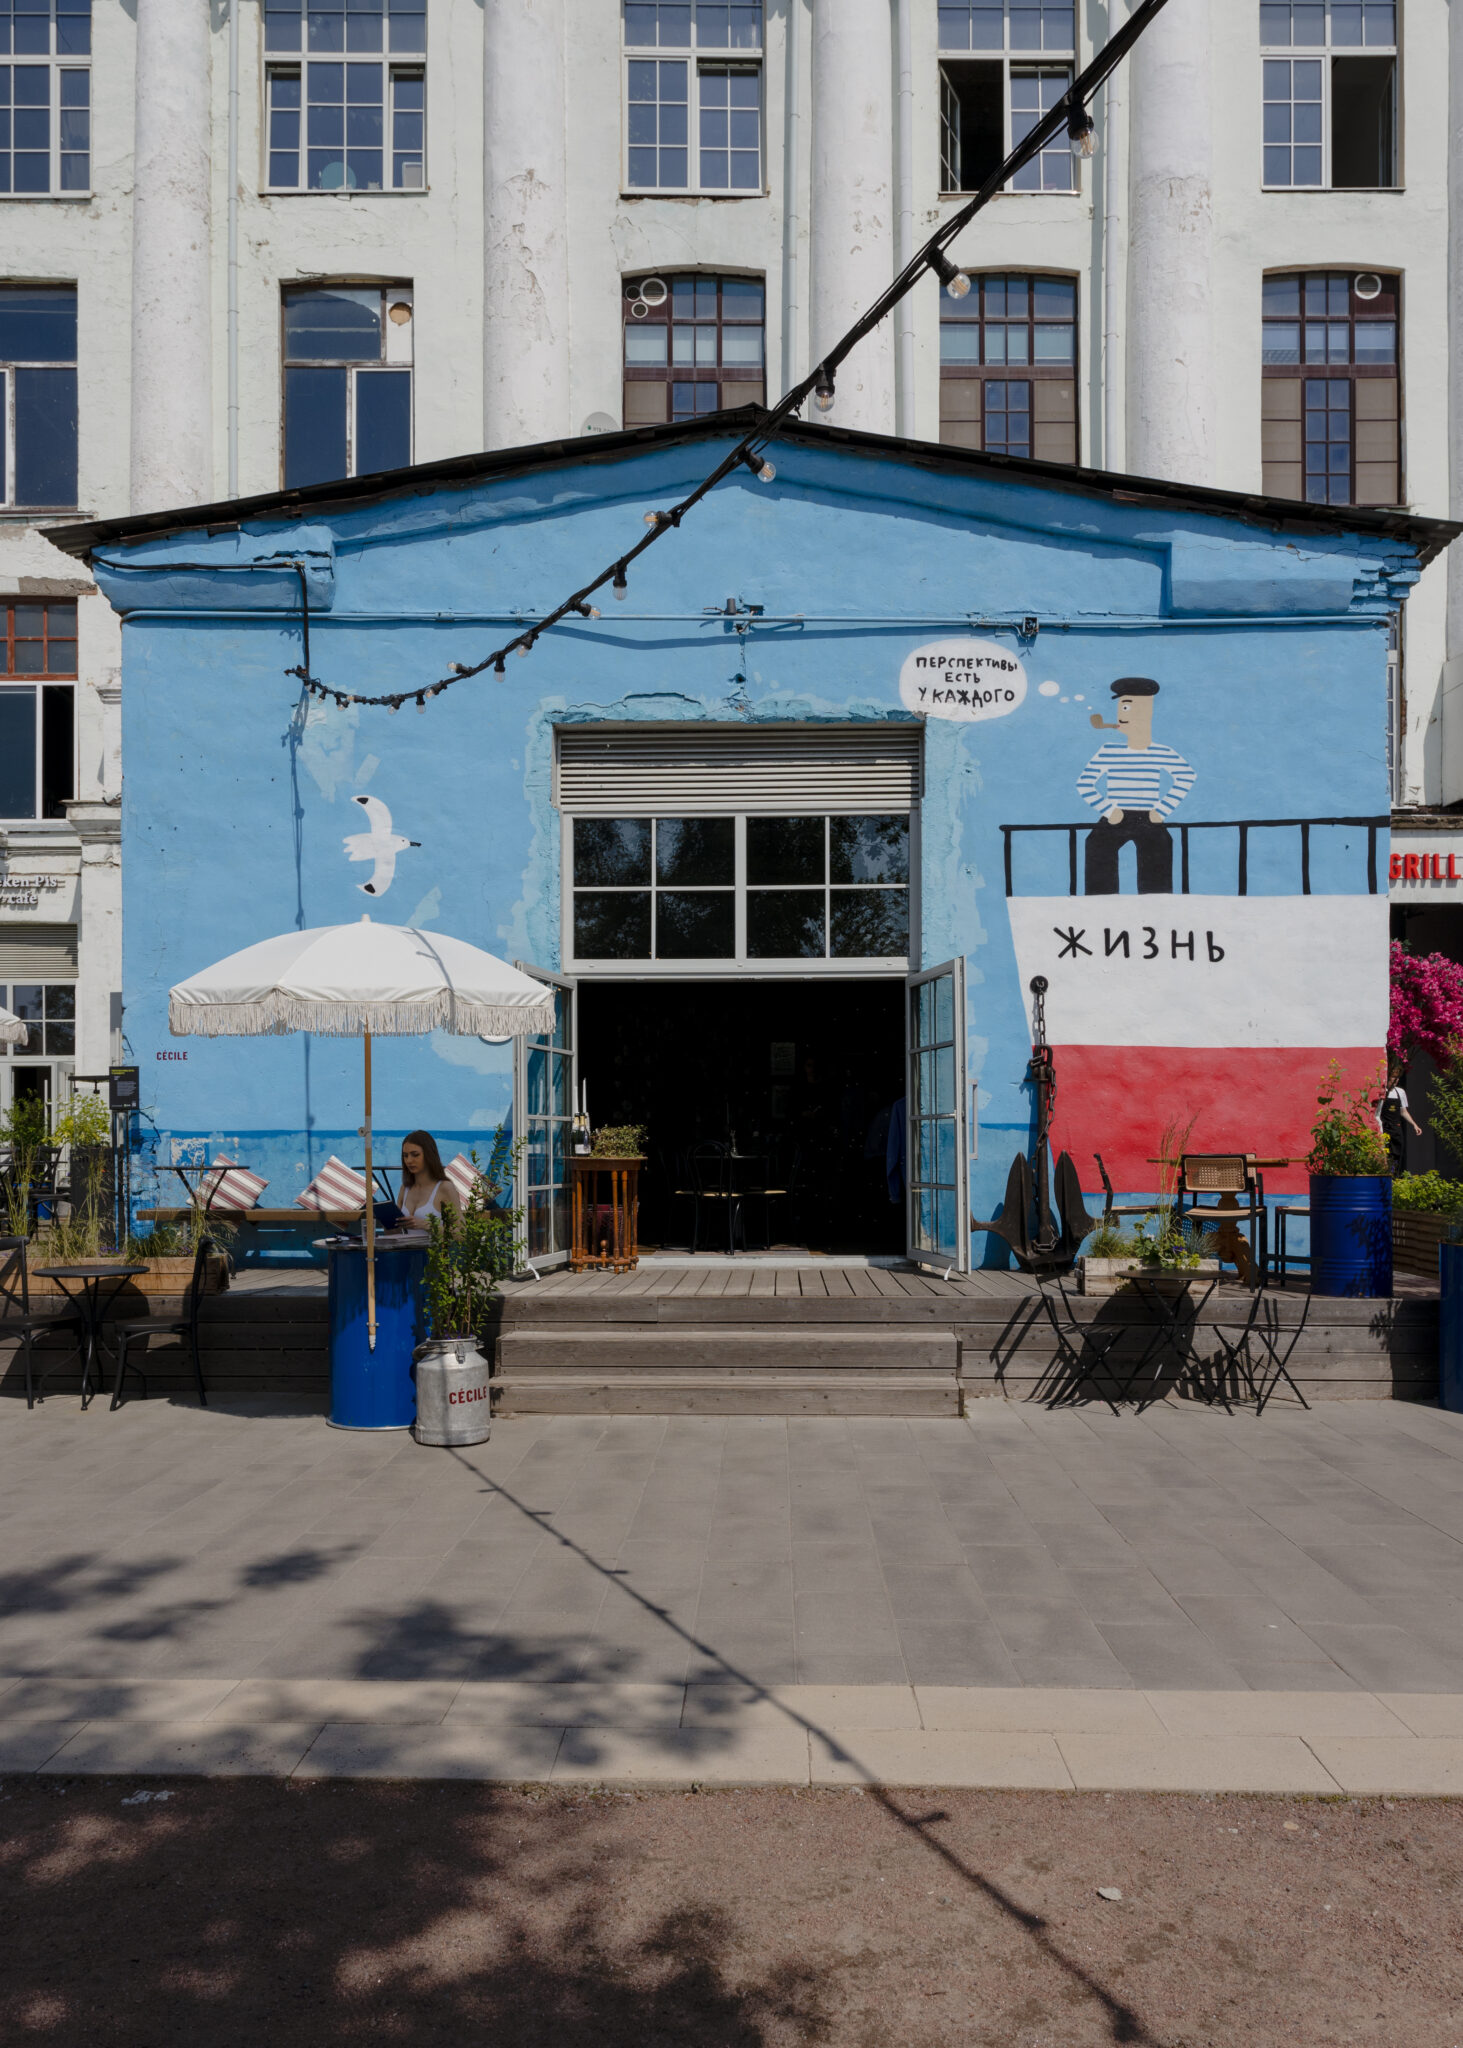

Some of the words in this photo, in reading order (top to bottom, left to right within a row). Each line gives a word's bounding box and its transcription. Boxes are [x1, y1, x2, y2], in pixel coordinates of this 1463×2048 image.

[916, 656, 1018, 672] ПЕРСПЕКТИВЫ
[945, 672, 981, 684] ЕСТЬ
[918, 687, 927, 701] У
[932, 688, 1015, 708] КАЖДОГО
[1389, 853, 1462, 879] GRILL
[34, 876, 58, 888] Pis
[1053, 926, 1225, 962] ЖИЗНЬ
[156, 1050, 188, 1061] CÉCILE
[448, 1386, 487, 1405] CÉCILE
